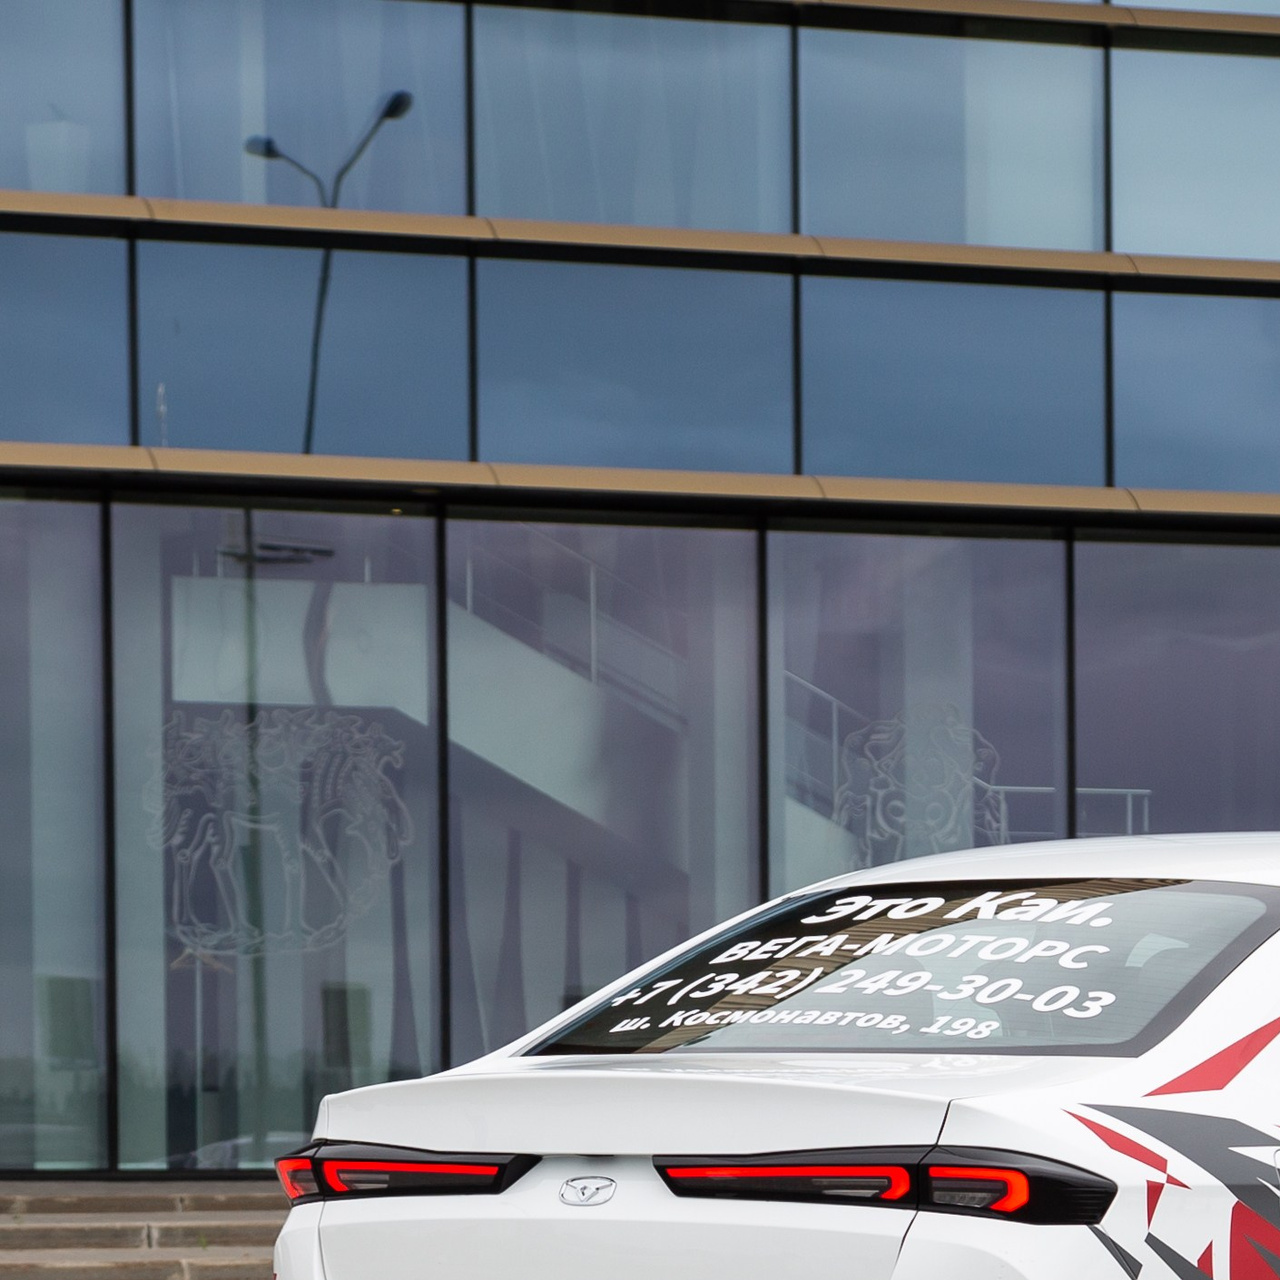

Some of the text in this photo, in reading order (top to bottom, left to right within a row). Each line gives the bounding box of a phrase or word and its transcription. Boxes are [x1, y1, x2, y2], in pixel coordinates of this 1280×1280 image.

[801, 895, 946, 924] Это
[708, 933, 1110, 969] ВЕГА-МОТОРС
[611, 967, 1117, 1019] +7 (342) 249-30-03
[609, 1008, 999, 1039] ш. Космонавтов, 198
